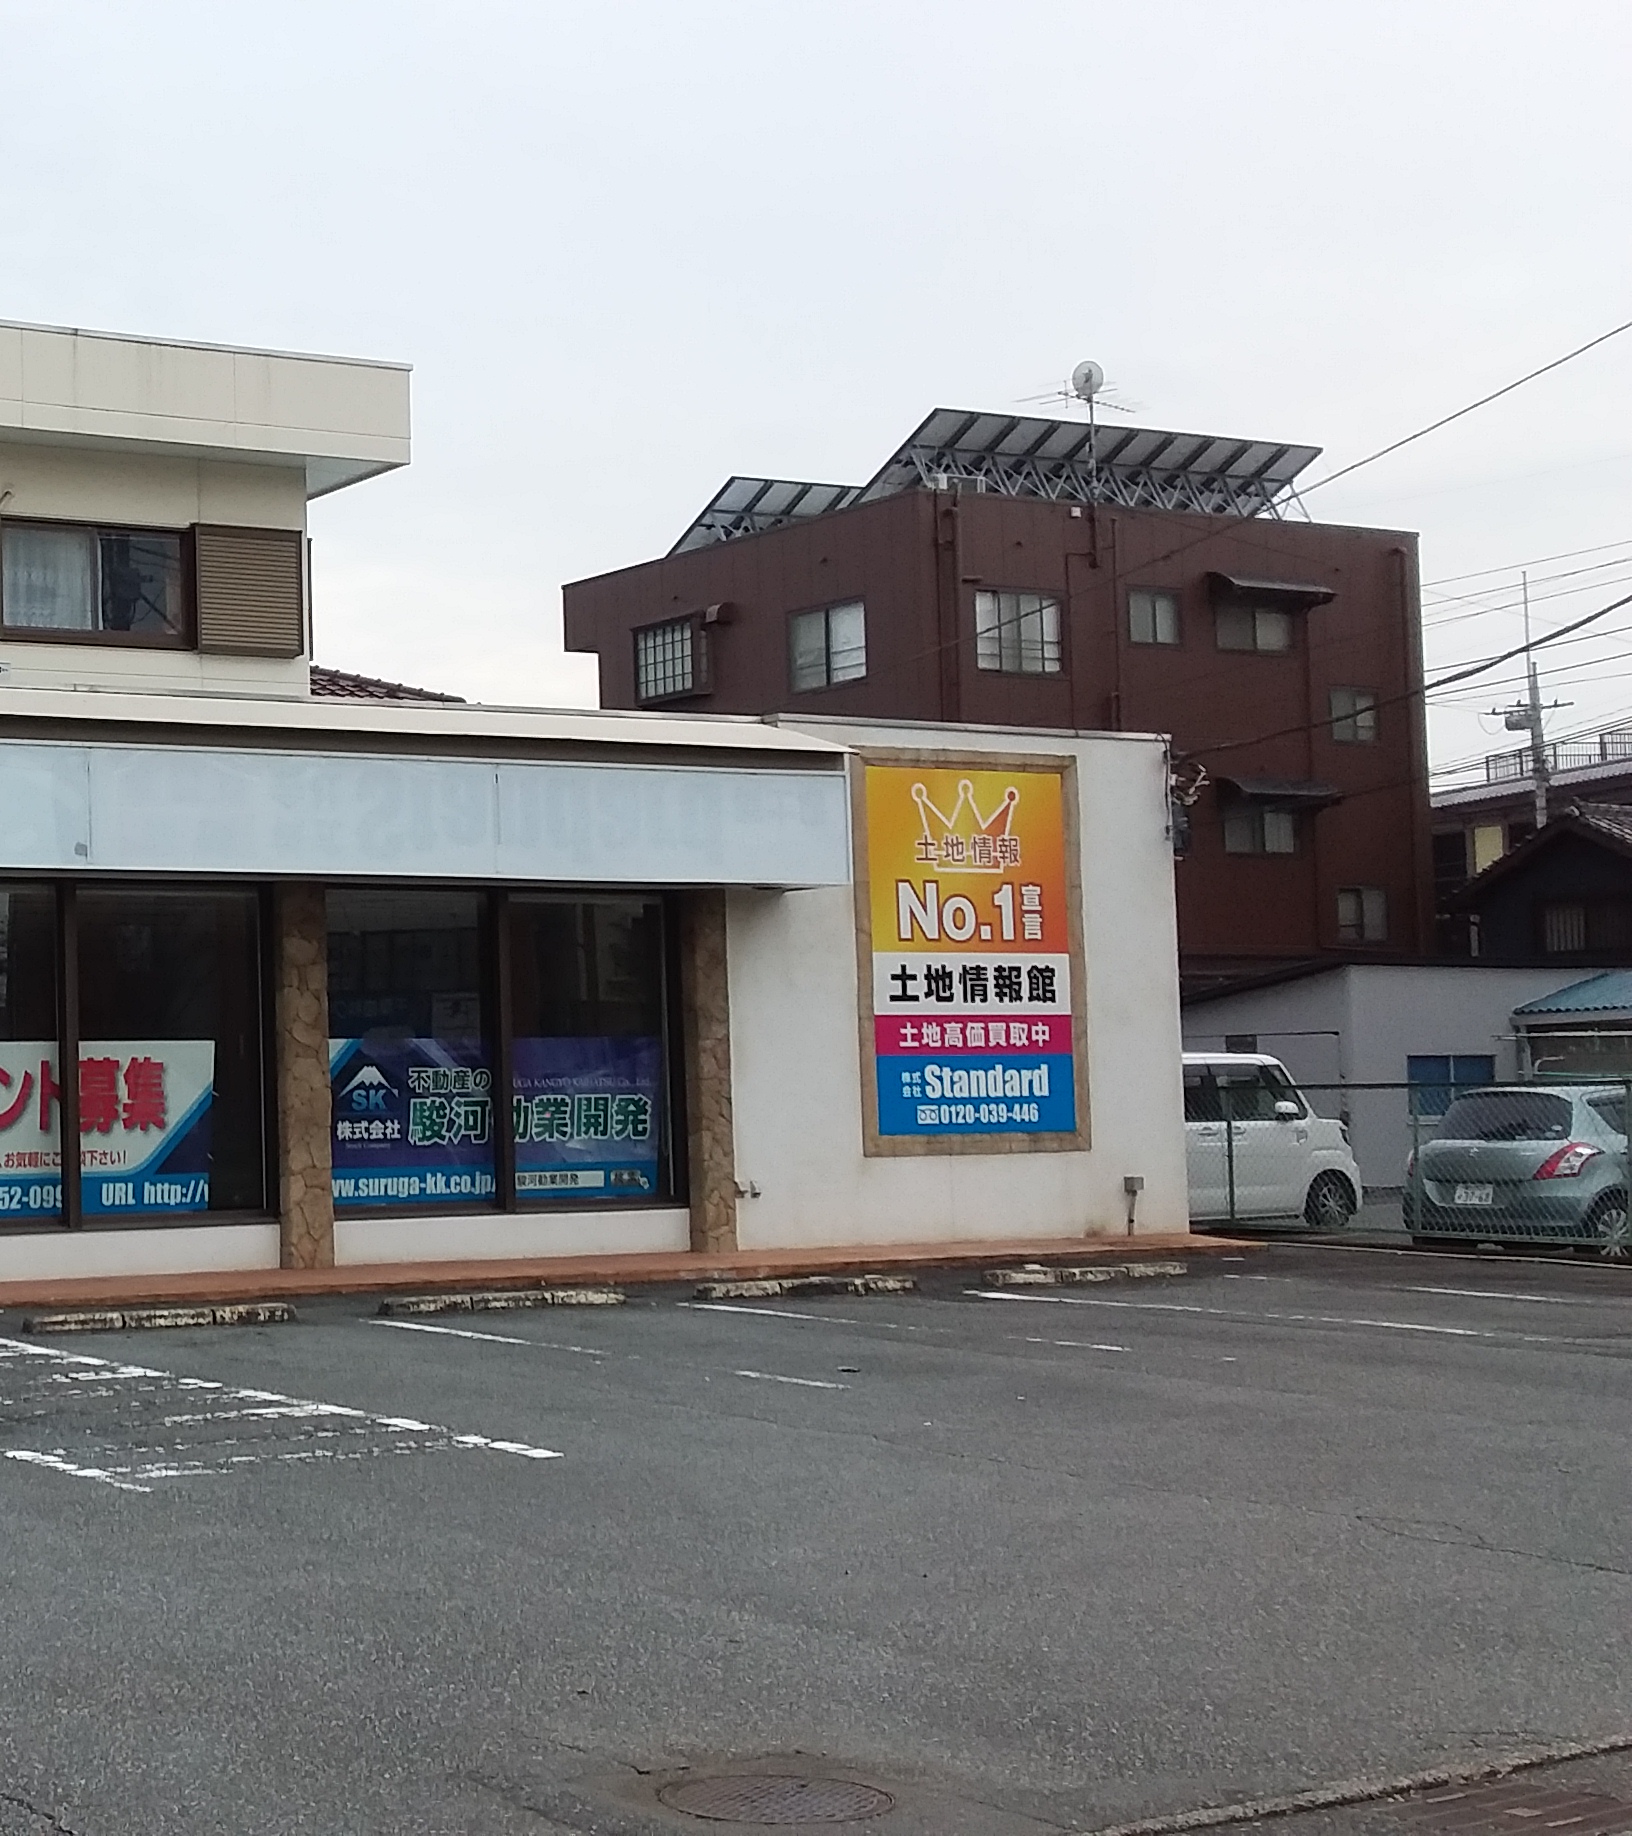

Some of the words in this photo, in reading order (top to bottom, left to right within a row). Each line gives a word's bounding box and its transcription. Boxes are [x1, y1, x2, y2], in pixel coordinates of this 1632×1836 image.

[915, 834, 1021, 866] 土地情報
[896, 881, 1016, 942] No.1
[1020, 885, 1043, 941] 宣言
[888, 963, 1058, 1004] 土地情報館
[898, 1021, 1051, 1048] 土地高価買取中
[409, 1067, 492, 1094] 不動産の
[924, 1063, 1050, 1099] Standard
[351, 1088, 387, 1111] SK
[940, 1103, 1039, 1124] 0120-039-446
[336, 1119, 401, 1141] 株式会社
[101, 1182, 136, 1206] URL
